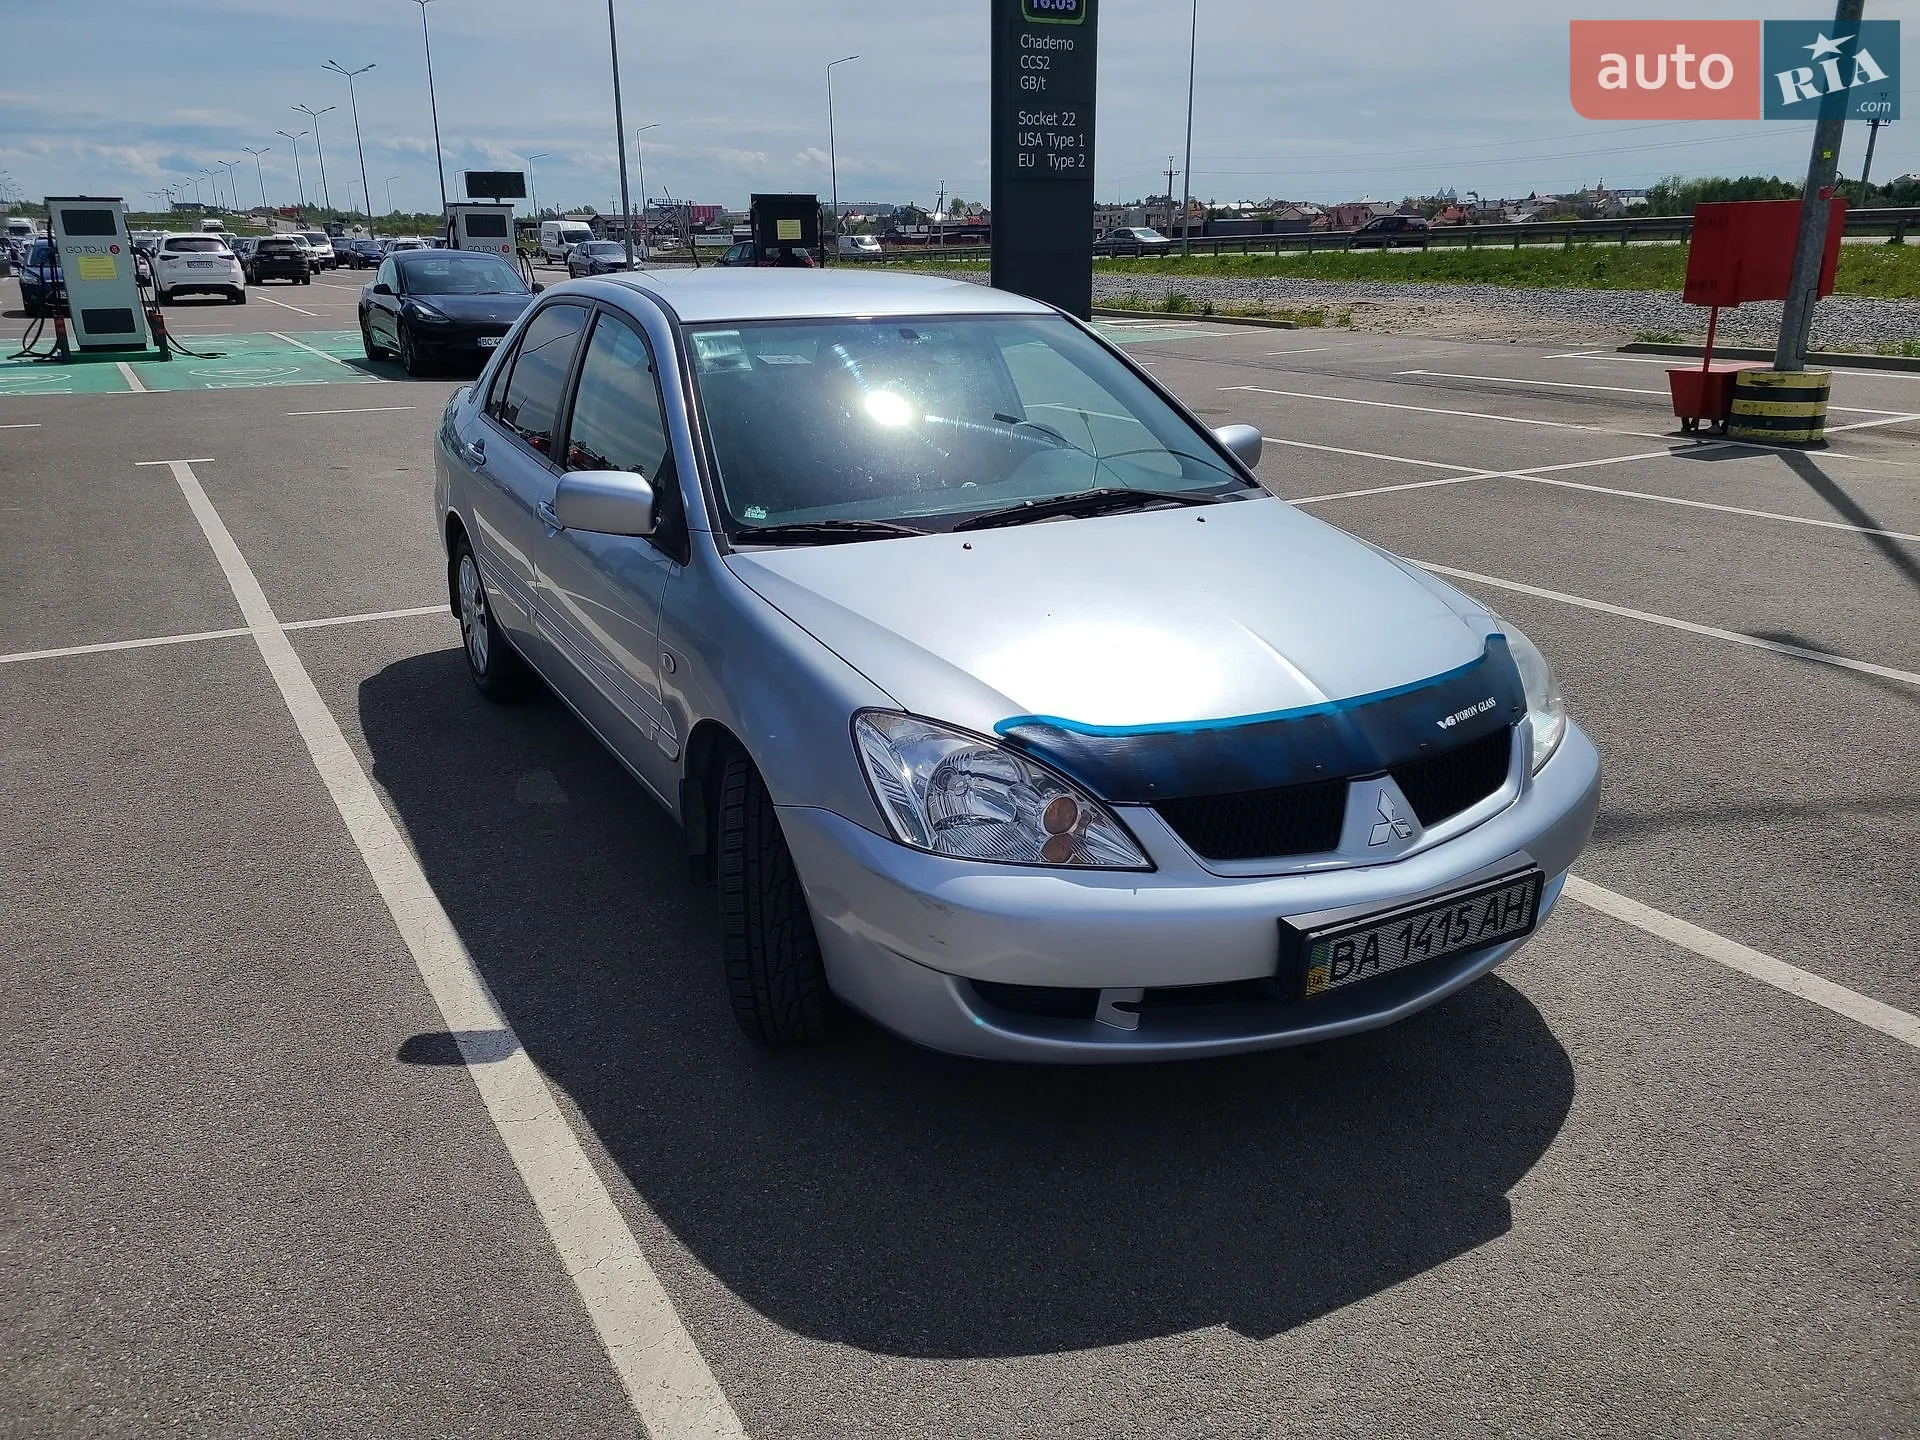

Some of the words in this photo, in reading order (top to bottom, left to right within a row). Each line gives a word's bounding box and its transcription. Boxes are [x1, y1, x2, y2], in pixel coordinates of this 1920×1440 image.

[1020, 34, 1074, 51] Chademo
[1020, 55, 1050, 70] CCS2
[1020, 76, 1046, 92] GB/t
[1018, 111, 1058, 126] Socket
[1061, 112, 1076, 126] 22
[1018, 132, 1043, 147] USA
[1047, 133, 1074, 150] Type
[1078, 133, 1085, 147] 1
[1018, 153, 1035, 168] EU
[1047, 154, 1074, 171] Type
[1078, 154, 1085, 168] 2
[1454, 704, 1479, 722] VORON
[1478, 696, 1497, 712] GLASS
[1329, 933, 1380, 982] BA
[1398, 906, 1473, 960] 1415
[1478, 886, 1528, 936] AH
